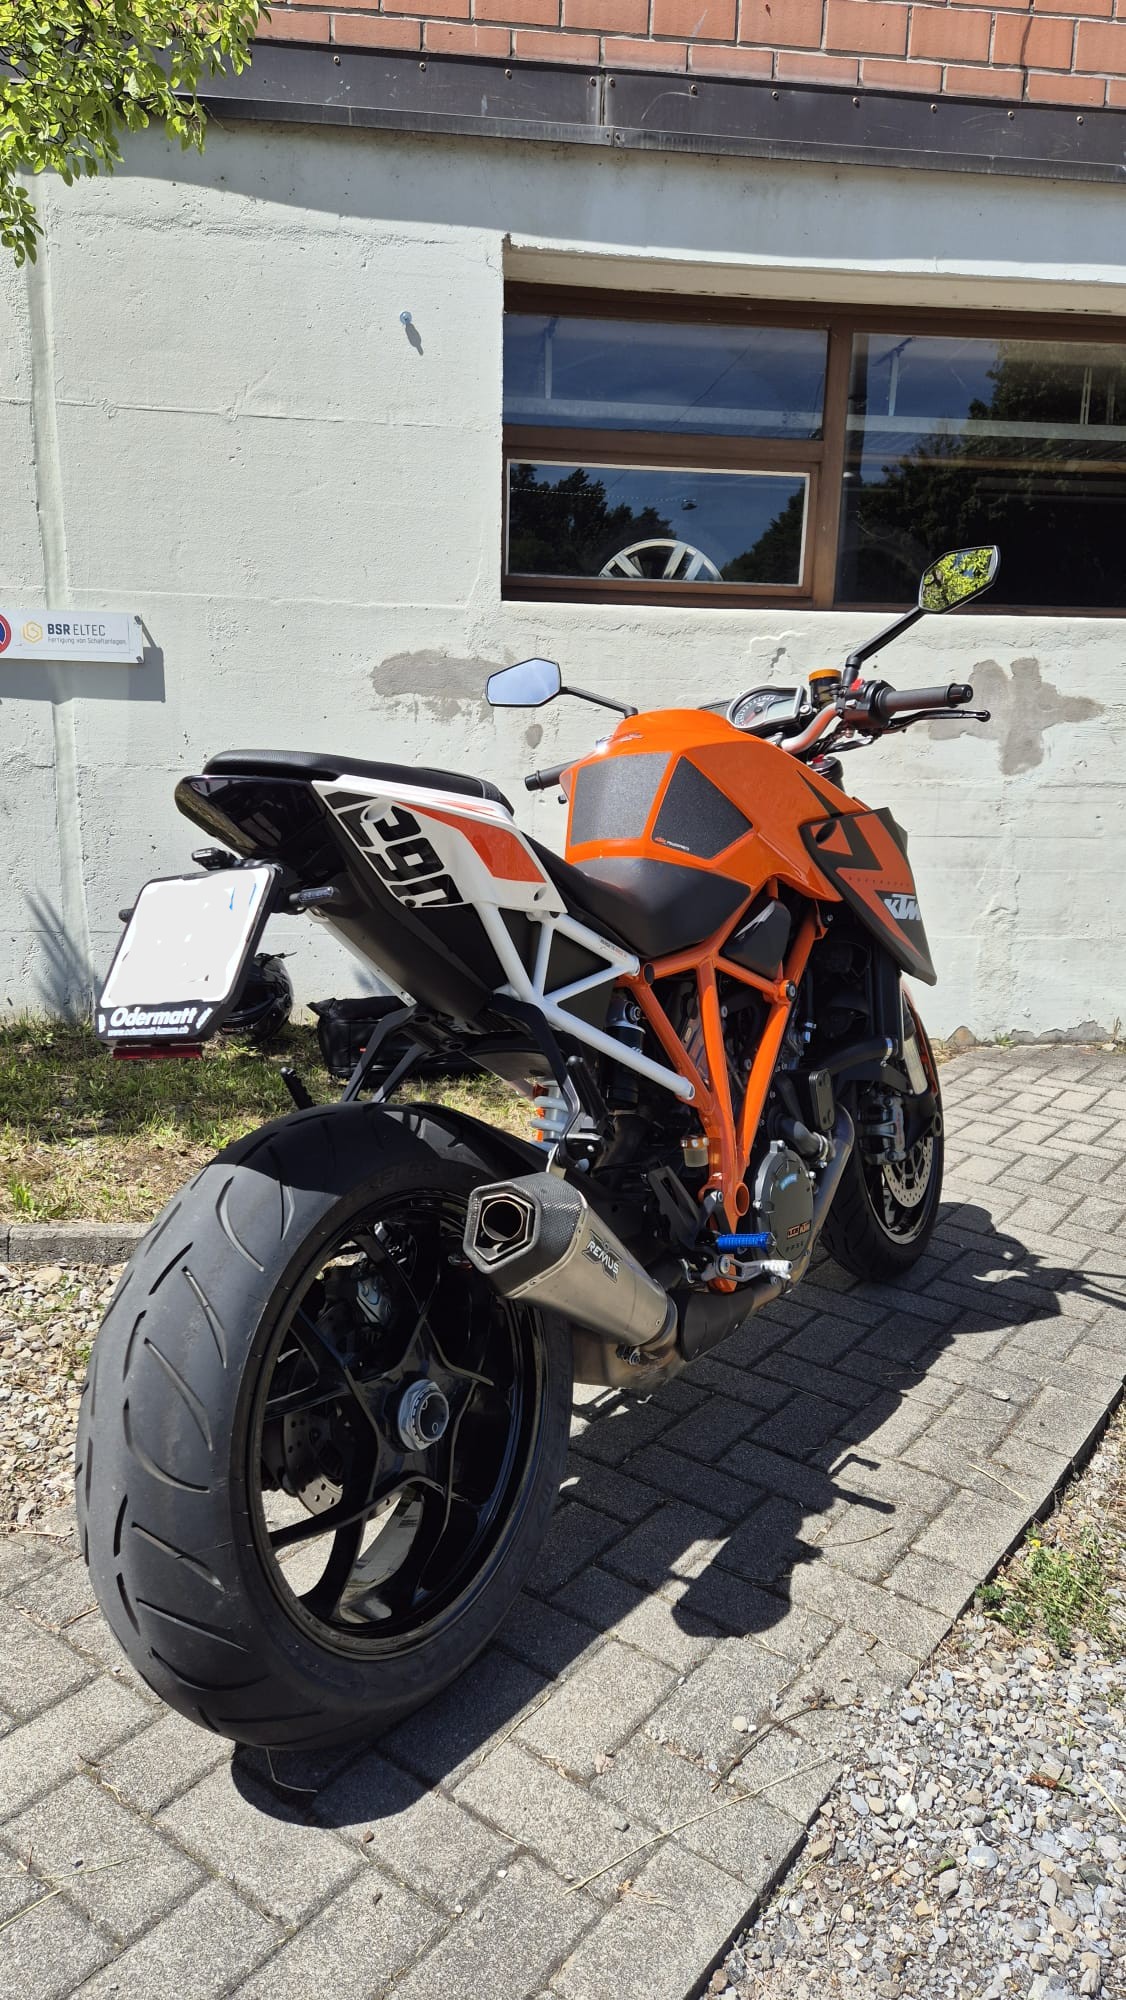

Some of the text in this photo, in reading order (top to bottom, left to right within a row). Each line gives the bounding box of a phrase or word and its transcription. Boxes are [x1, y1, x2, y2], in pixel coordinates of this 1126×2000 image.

[47, 623, 106, 636] BSR ELTEC
[884, 893, 922, 921] KTM
[110, 1007, 198, 1027] Odermatt
[587, 1240, 619, 1274] REMUS
